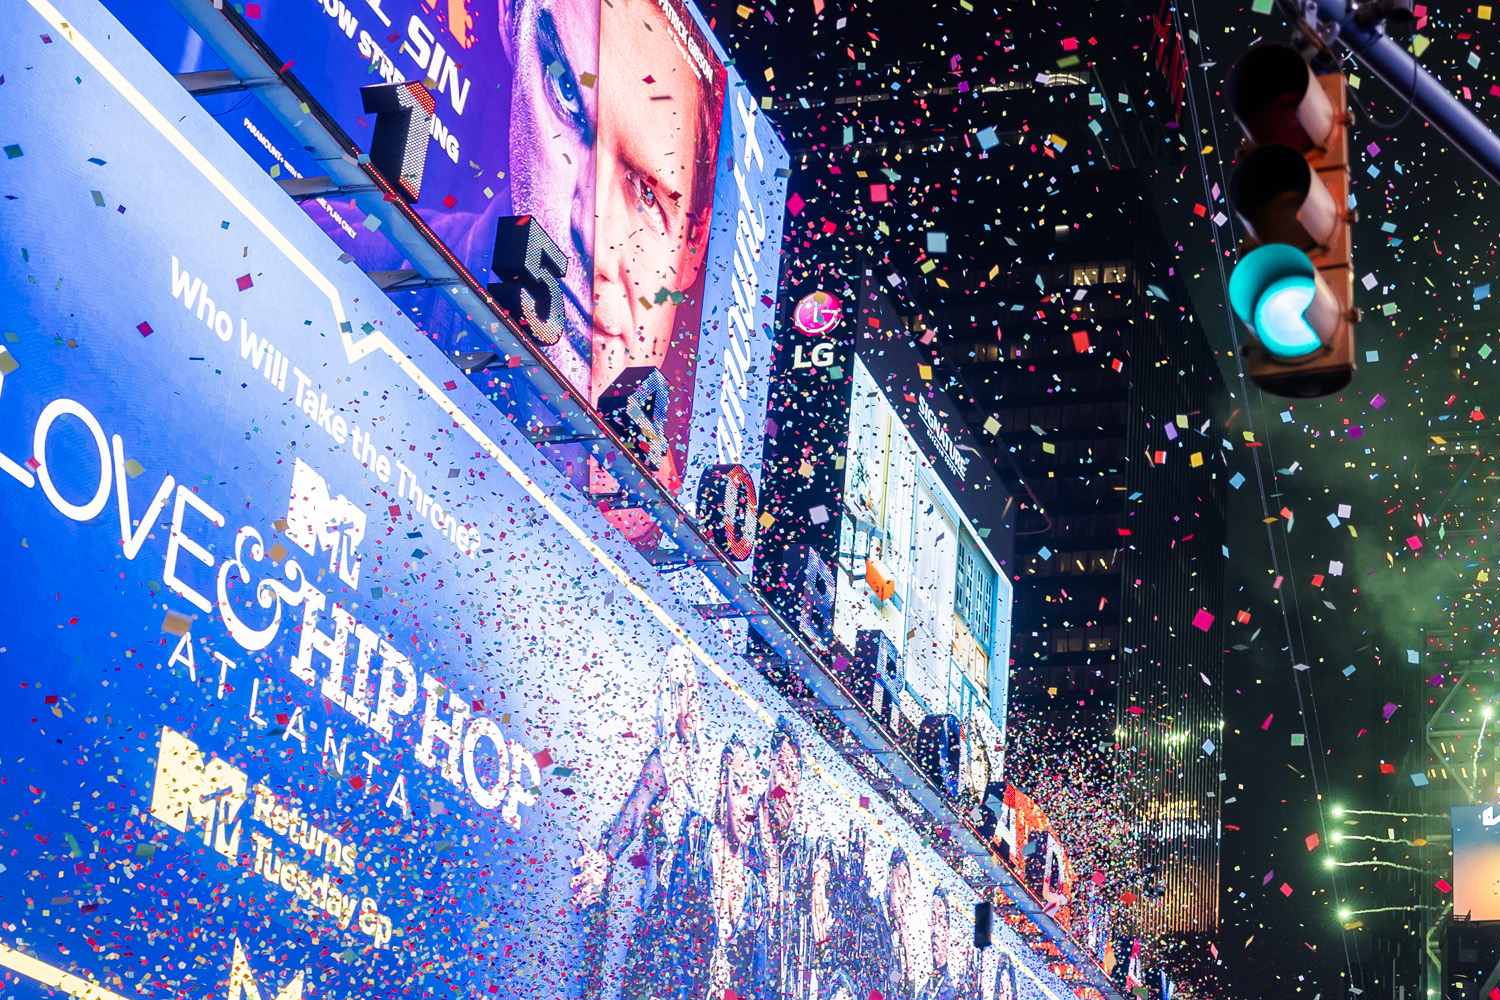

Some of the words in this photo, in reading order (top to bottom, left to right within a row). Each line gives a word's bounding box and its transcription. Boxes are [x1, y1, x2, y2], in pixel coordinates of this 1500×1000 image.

[318, 0, 359, 40] OW
[357, 30, 461, 164] STREING
[403, 14, 471, 116] SIN
[687, 36, 713, 84] GIBSON
[170, 253, 234, 343] Who
[239, 331, 291, 393] Will
[292, 366, 348, 442] Take
[349, 424, 393, 482] the
[395, 456, 482, 560] Throne?
[793, 342, 835, 369] LG
[918, 393, 967, 478] SIGNATURE
[168, 630, 411, 812] ATLANTA
[253, 780, 359, 877] Returns
[250, 832, 359, 938] Tuesday
